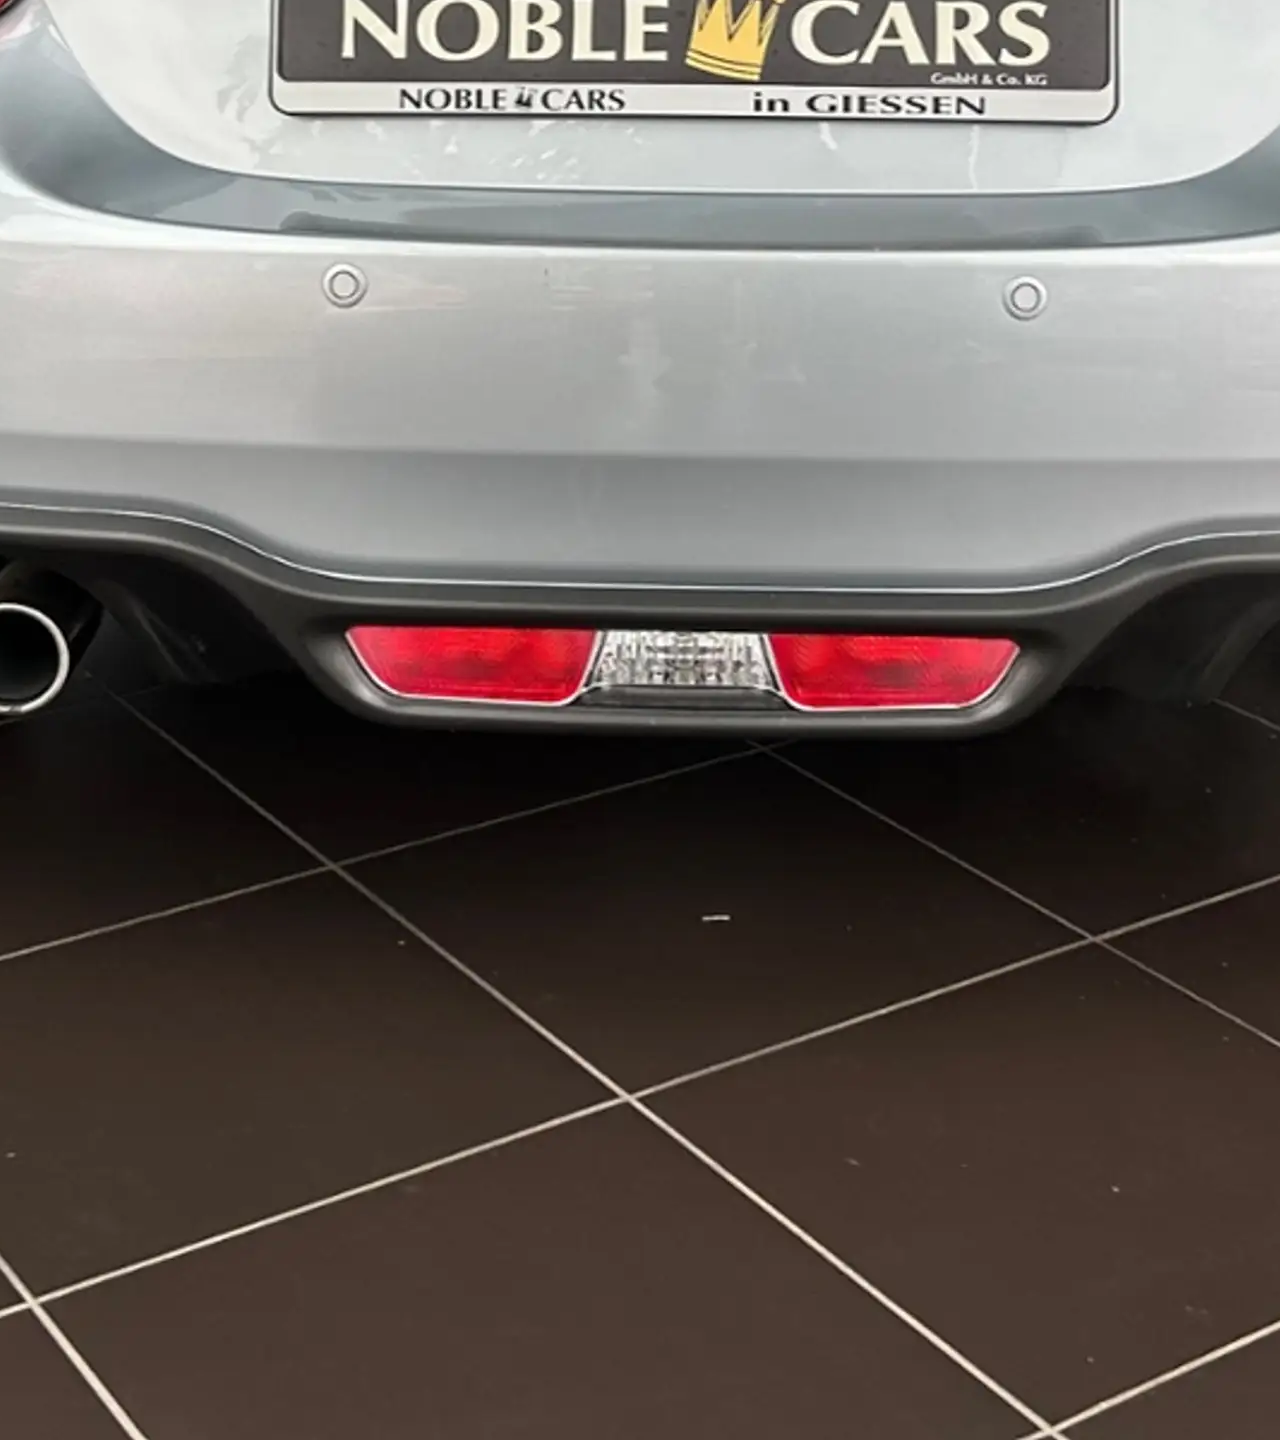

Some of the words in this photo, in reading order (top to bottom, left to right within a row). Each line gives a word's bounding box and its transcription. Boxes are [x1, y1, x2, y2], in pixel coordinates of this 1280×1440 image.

[930, 72, 978, 85] GmbH
[996, 72, 1022, 86] Co.
[1024, 73, 1049, 86] KG
[399, 88, 507, 111] NOBLE
[541, 89, 626, 111] CARS
[753, 92, 790, 113] in
[805, 94, 987, 116] GIESSEN
